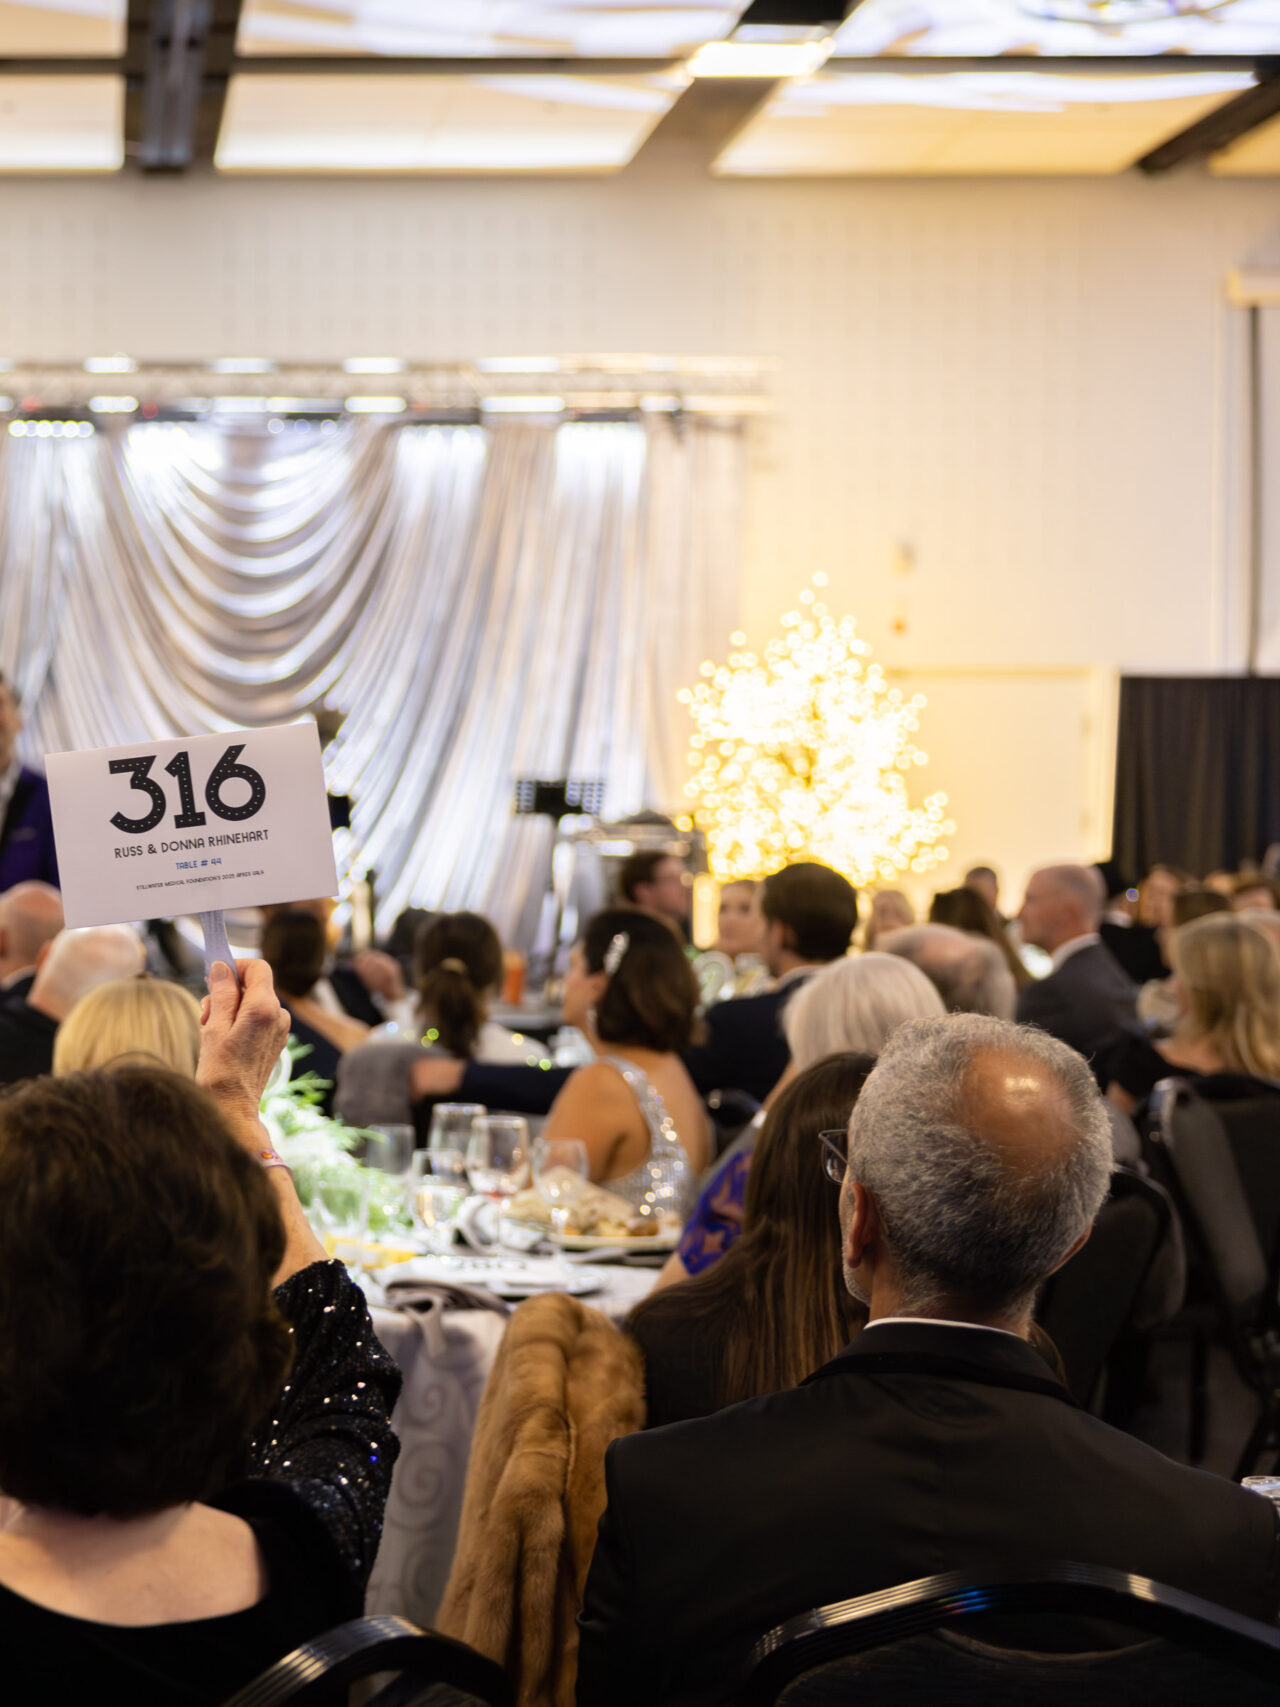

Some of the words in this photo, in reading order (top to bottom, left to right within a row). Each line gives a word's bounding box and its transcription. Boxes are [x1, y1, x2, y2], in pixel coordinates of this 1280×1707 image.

[108, 743, 267, 835] 316
[114, 845, 144, 859] RUSS
[147, 843, 158, 855] &
[161, 837, 206, 854] DONNA
[207, 829, 270, 848] RHINEHART
[175, 860, 198, 870] TABLE
[201, 859, 209, 867] #
